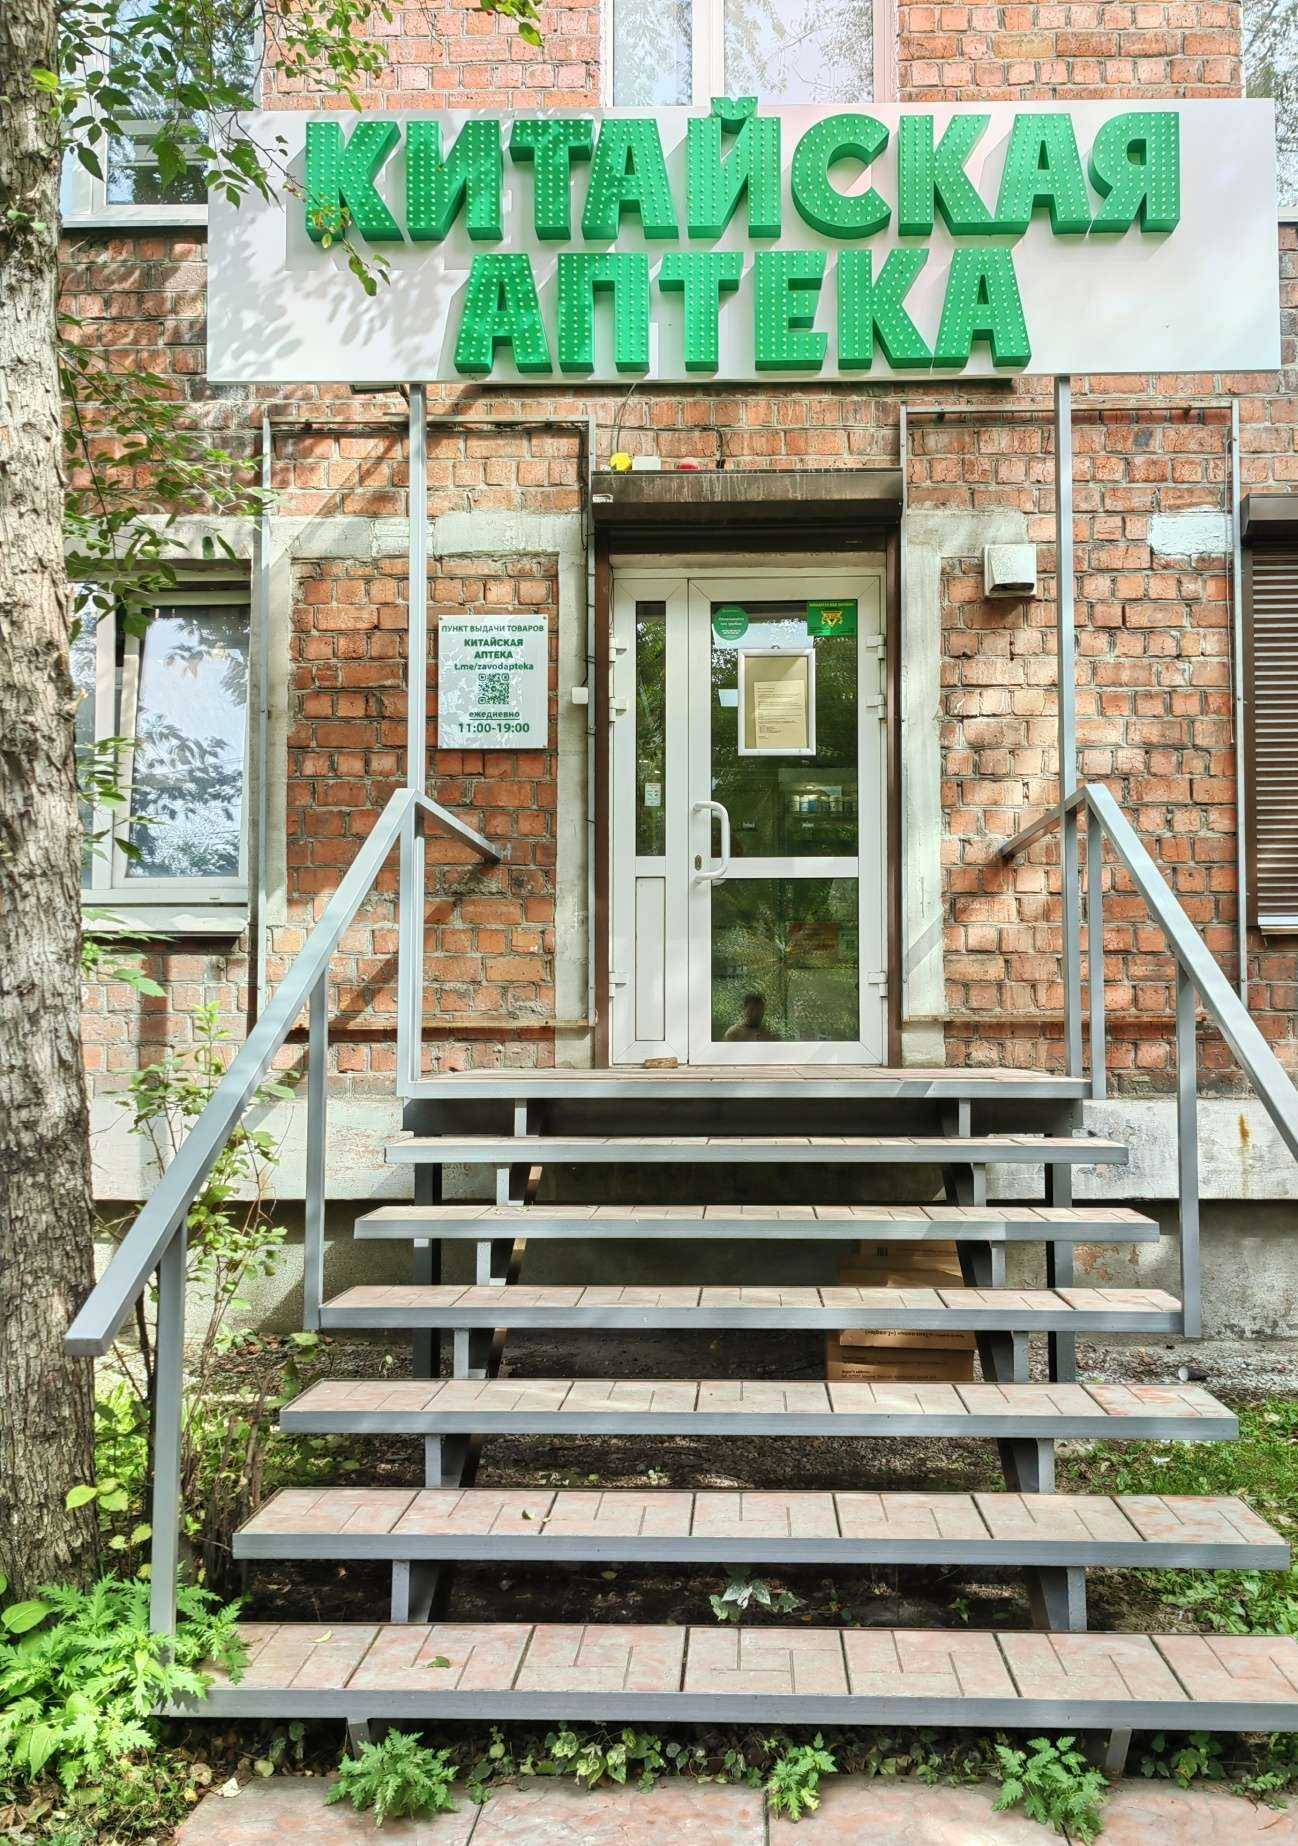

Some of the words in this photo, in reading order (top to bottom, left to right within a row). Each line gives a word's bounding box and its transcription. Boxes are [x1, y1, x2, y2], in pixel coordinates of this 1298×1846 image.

[304, 96, 1181, 242] КИТАЙСКАЯ
[453, 248, 1031, 374] АПТЕКА
[470, 625, 506, 633] ВЫДАЧИ
[464, 637, 524, 647] КИТАЙСКАЯ
[474, 651, 513, 659] АПТЕКА
[454, 663, 534, 671] t.me/zavodapteka
[458, 723, 530, 733] 11:00-19:00
